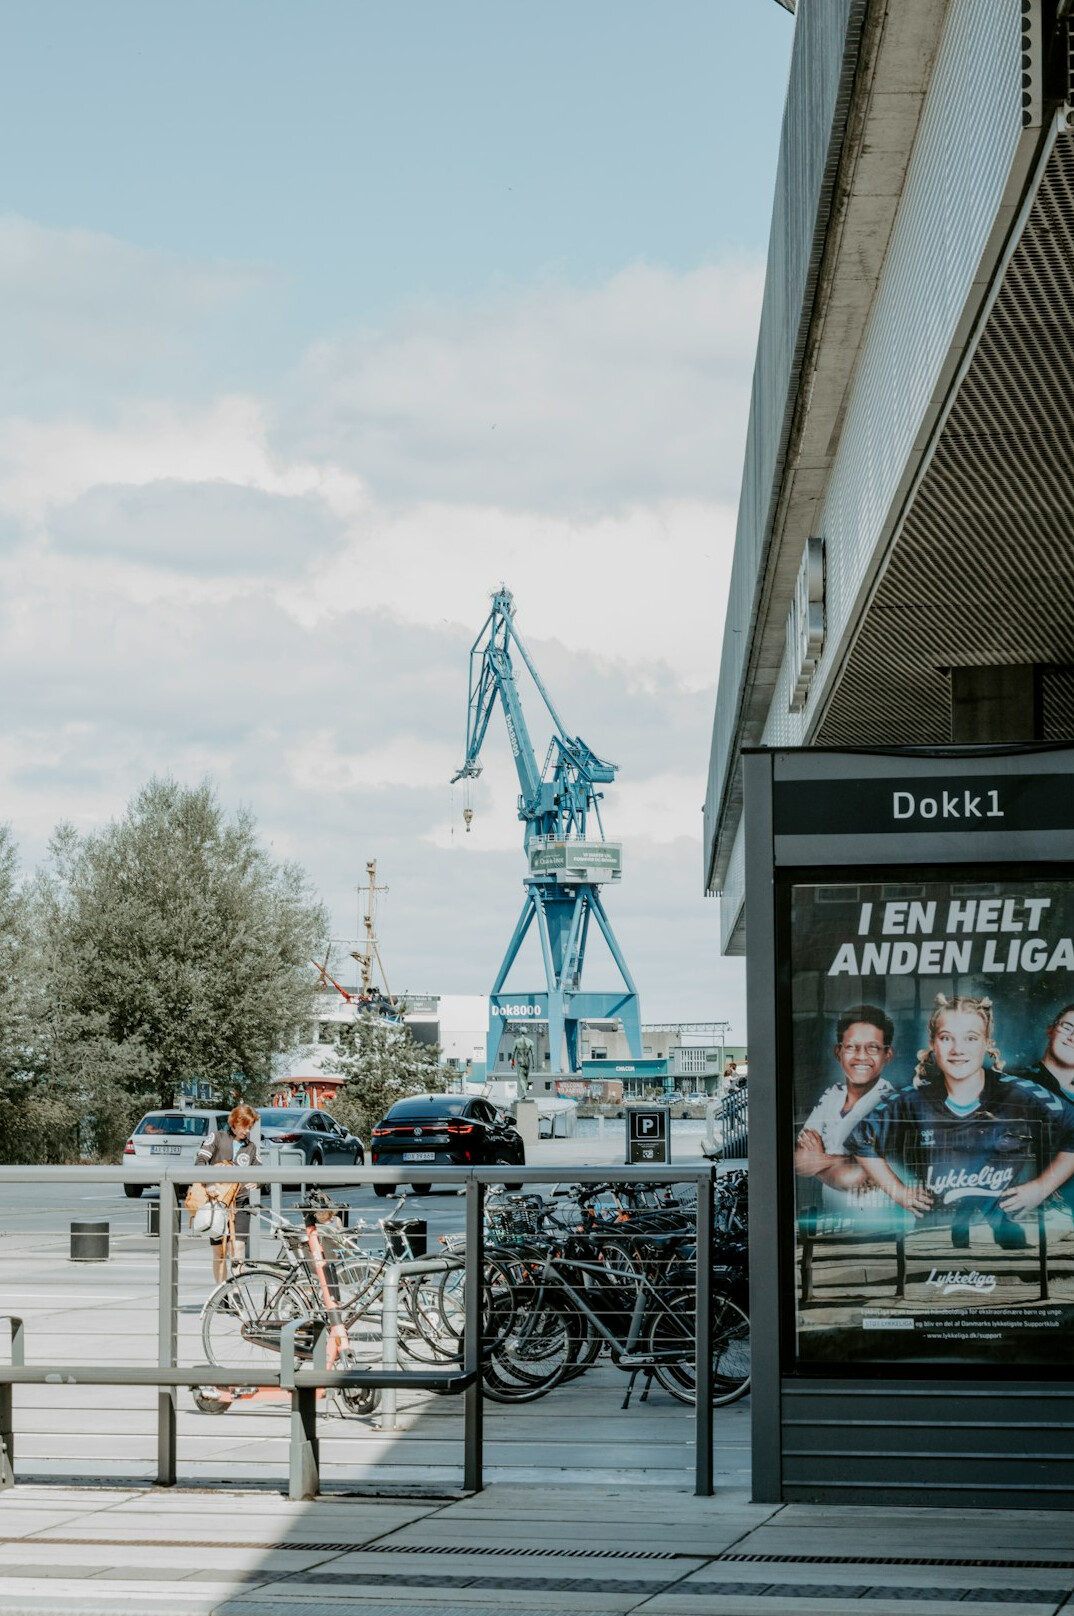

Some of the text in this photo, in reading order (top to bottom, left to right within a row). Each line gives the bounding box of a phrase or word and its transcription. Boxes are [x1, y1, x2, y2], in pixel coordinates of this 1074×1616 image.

[505, 713, 520, 757] Dok8000
[892, 790, 1005, 819] Dokk1
[858, 898, 1051, 935] I EN HELT
[827, 938, 1074, 976] ANDEN LIGA
[491, 1003, 542, 1016] Dok8000
[642, 1118, 654, 1134] P
[927, 1166, 1013, 1196] Lykkeliga
[926, 1268, 997, 1292] Lykkeliga
